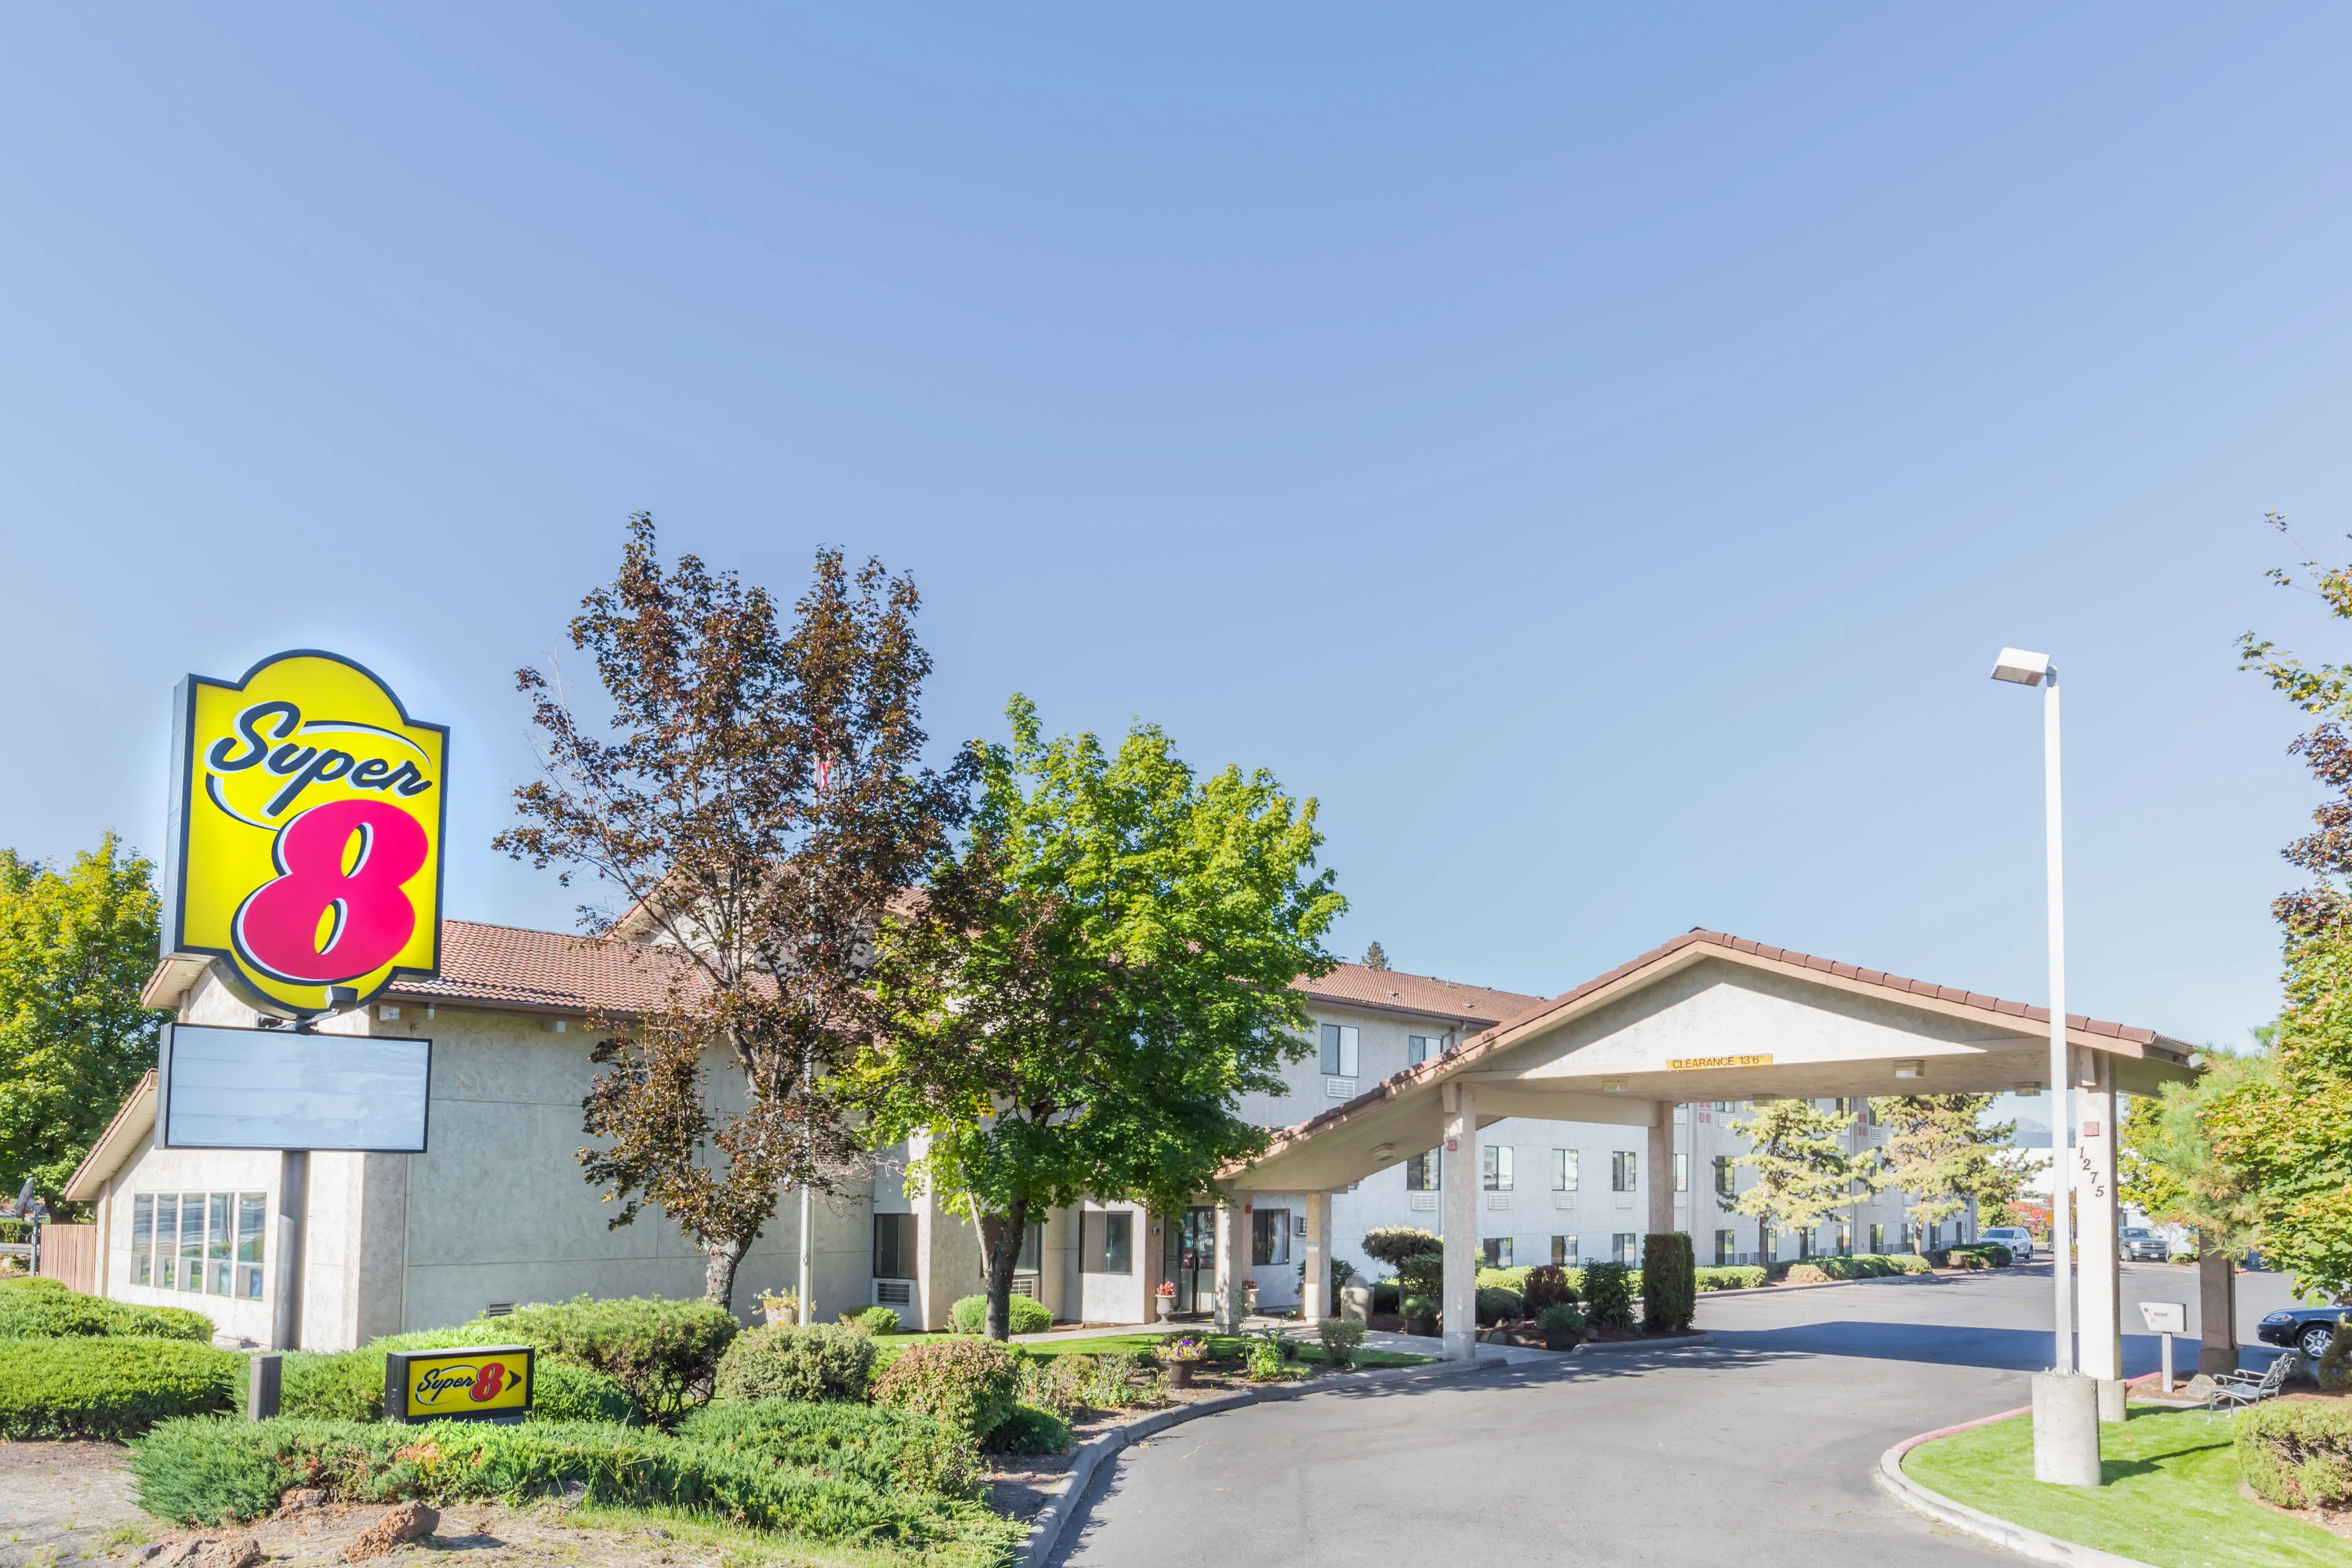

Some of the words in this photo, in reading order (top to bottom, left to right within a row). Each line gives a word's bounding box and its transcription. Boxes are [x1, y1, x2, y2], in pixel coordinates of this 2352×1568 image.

[205, 700, 433, 818] Super
[230, 799, 429, 986] 8
[1672, 1056, 1735, 1069] CLEARANCE
[416, 1368, 476, 1402] Super
[470, 1363, 506, 1402] 8
